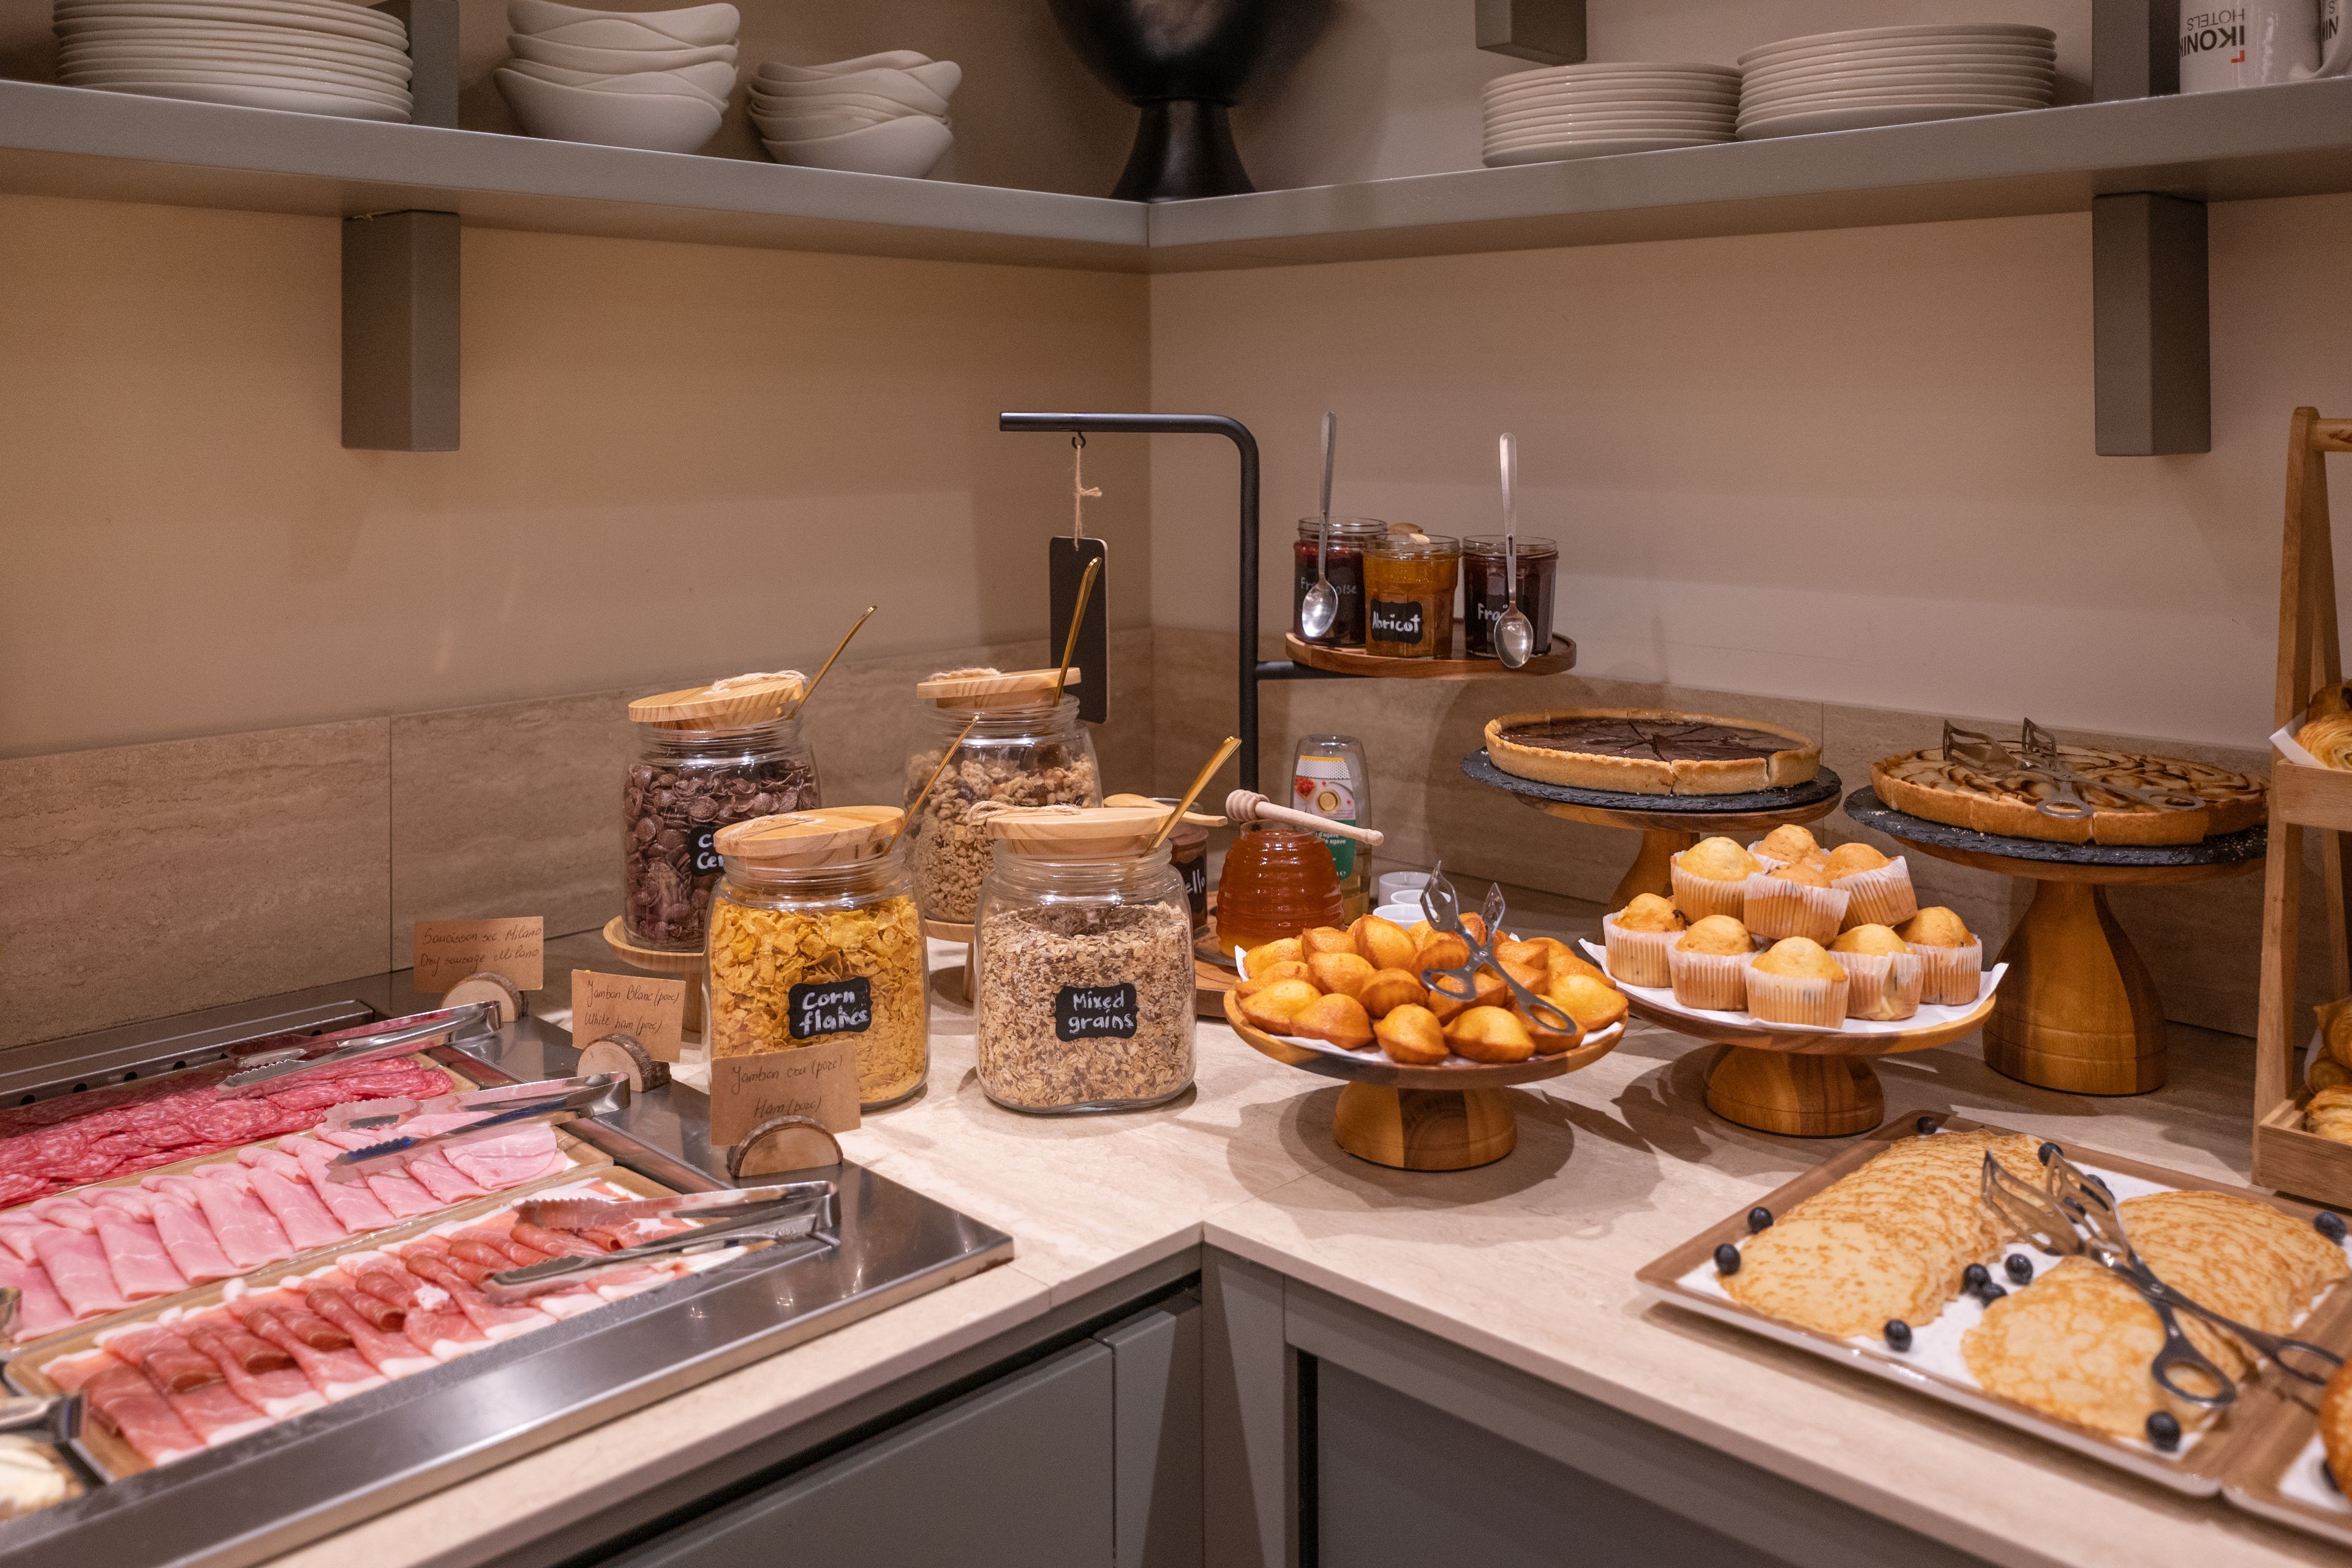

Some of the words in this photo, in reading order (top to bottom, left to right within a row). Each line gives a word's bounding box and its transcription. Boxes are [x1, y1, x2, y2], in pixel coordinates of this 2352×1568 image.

[2187, 8, 2245, 31] HOTELS
[1372, 611, 1420, 633] Abricot
[423, 928, 478, 944] Saucisson
[505, 924, 541, 941] Milano
[421, 954, 440, 976] Dry
[444, 954, 486, 973] sausage
[587, 980, 620, 1007] Jambon
[802, 991, 855, 1010] Corn
[1073, 989, 1124, 1011] Mixed
[584, 1012, 610, 1026] White
[614, 1017, 633, 1029] ham
[1069, 1009, 1134, 1034] grains
[731, 1066, 778, 1095] Jambon
[753, 1096, 785, 1118] Ham
